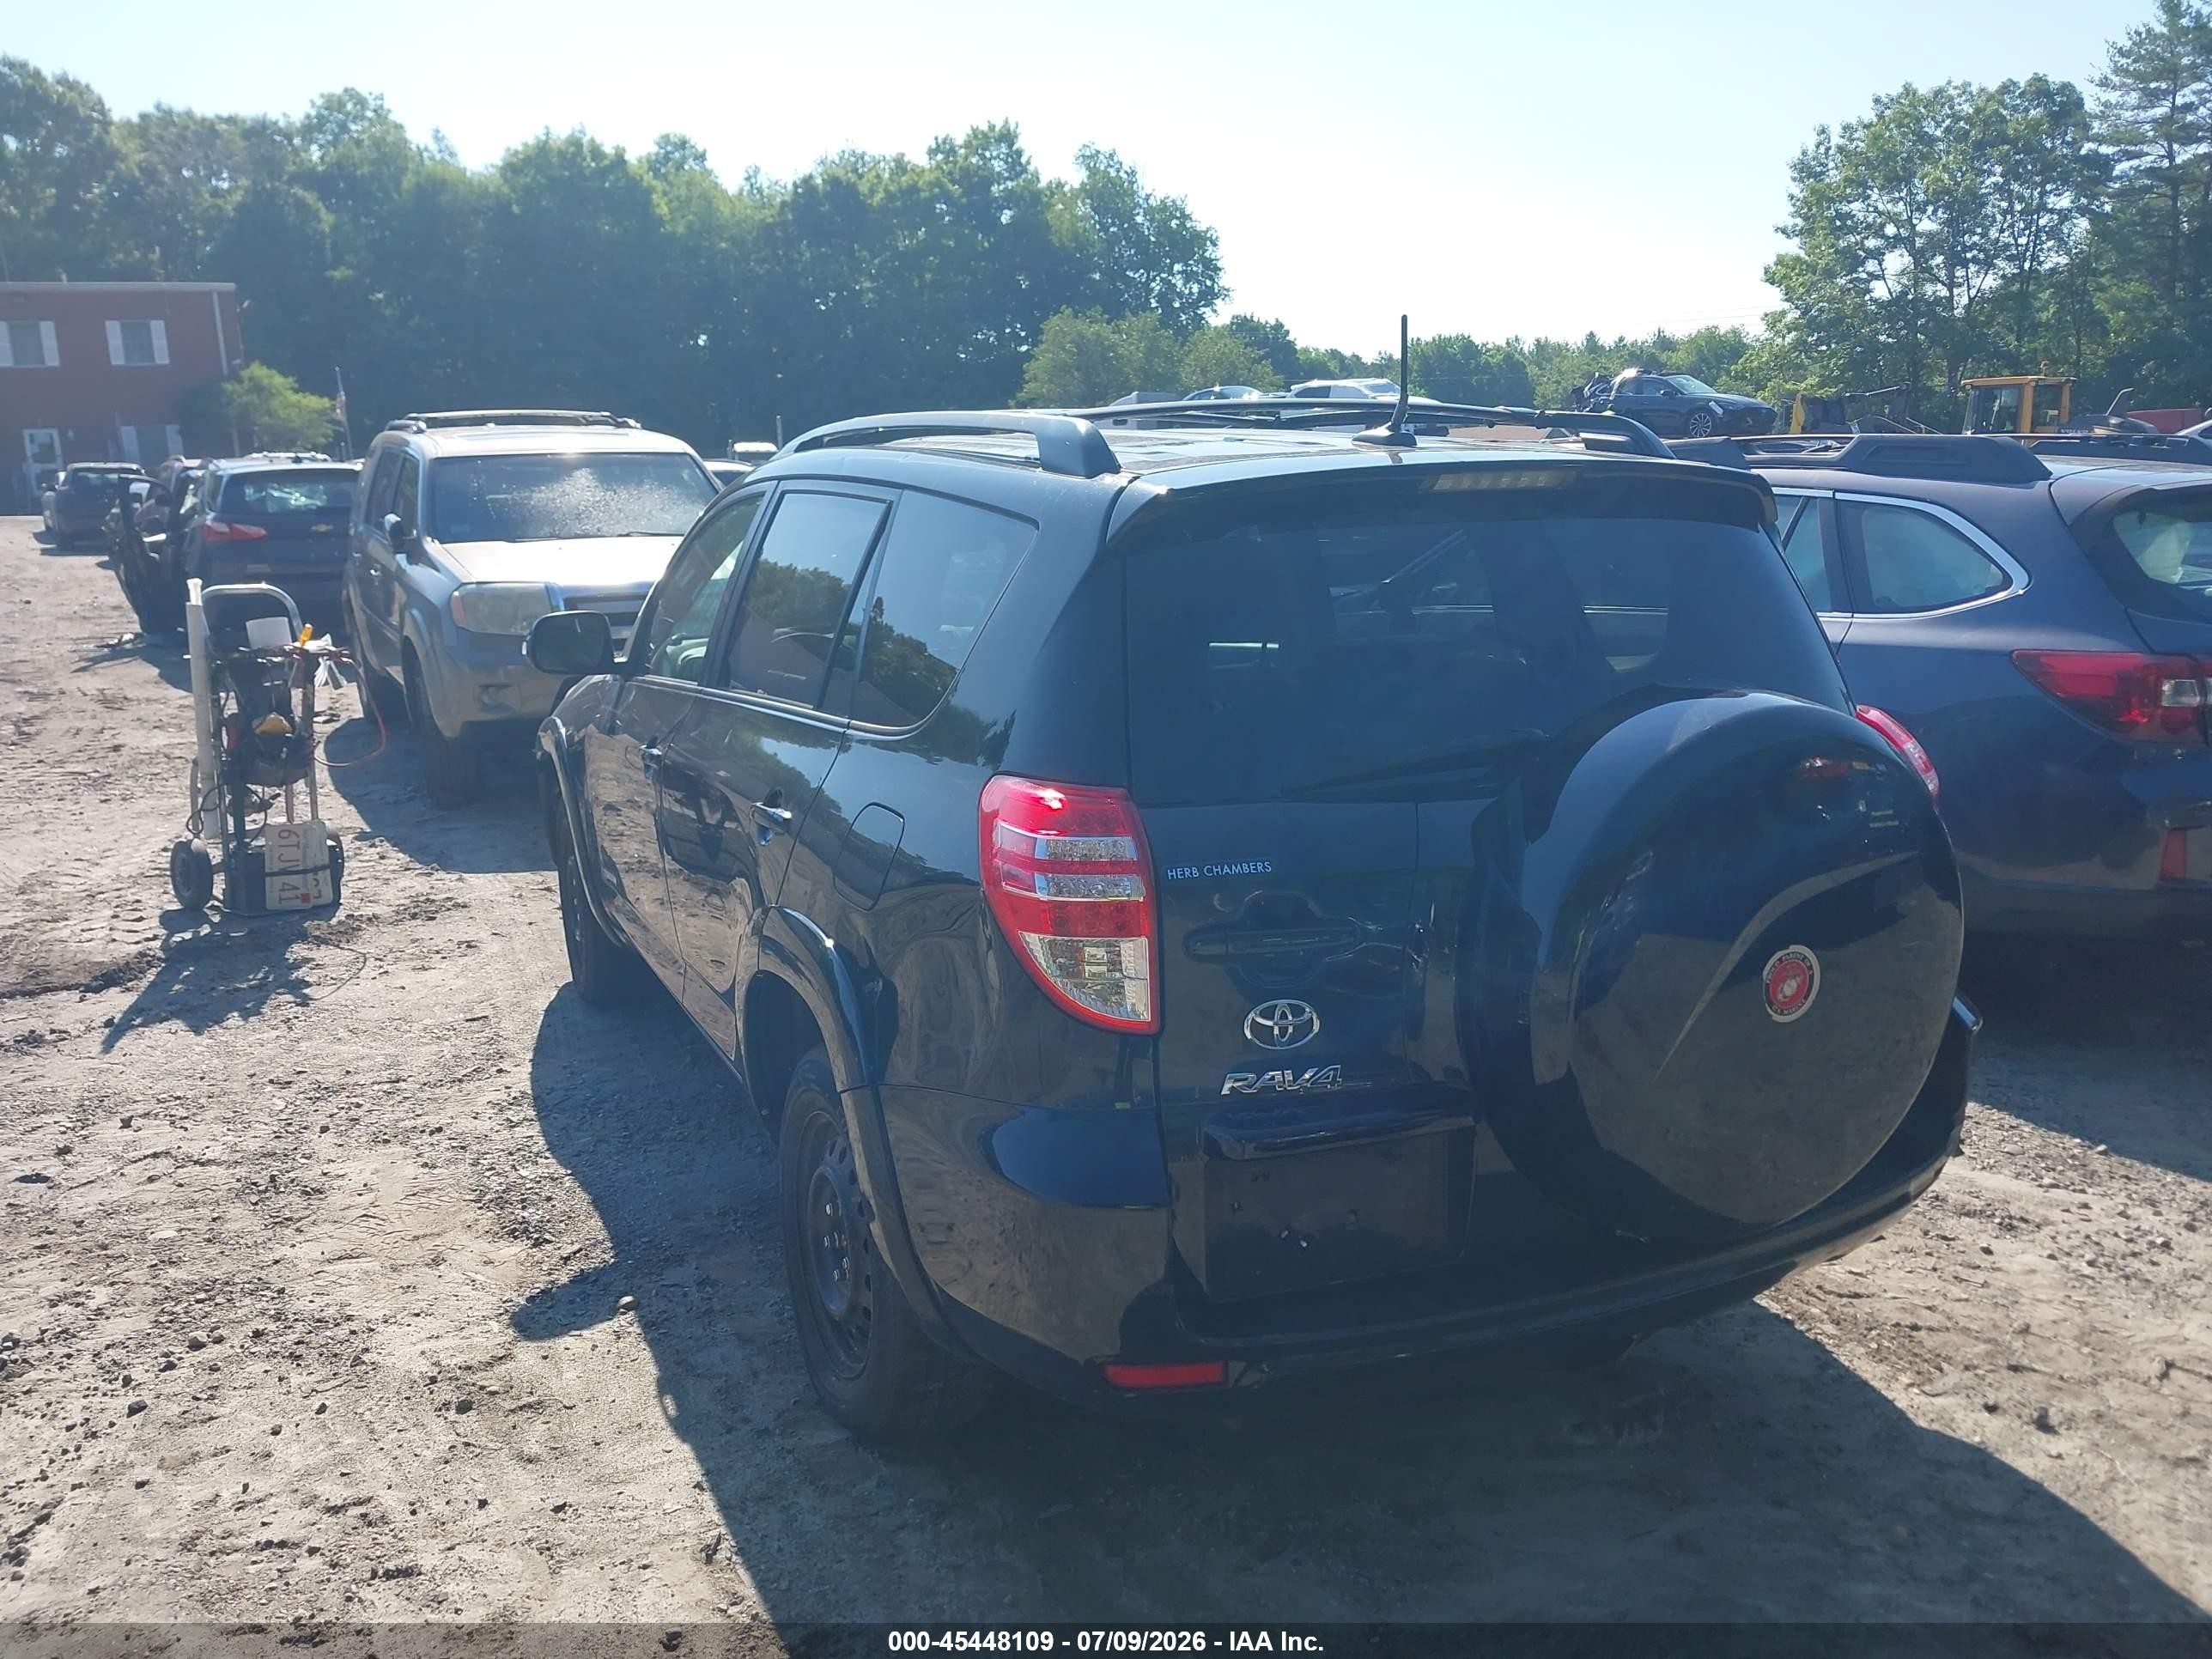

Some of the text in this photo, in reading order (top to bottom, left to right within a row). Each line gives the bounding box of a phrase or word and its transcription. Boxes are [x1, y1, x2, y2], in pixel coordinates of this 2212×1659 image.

[1167, 861, 1272, 880] HERB CHAMBERS
[278, 881, 301, 904] 41
[1220, 1064, 1342, 1096] RAV4
